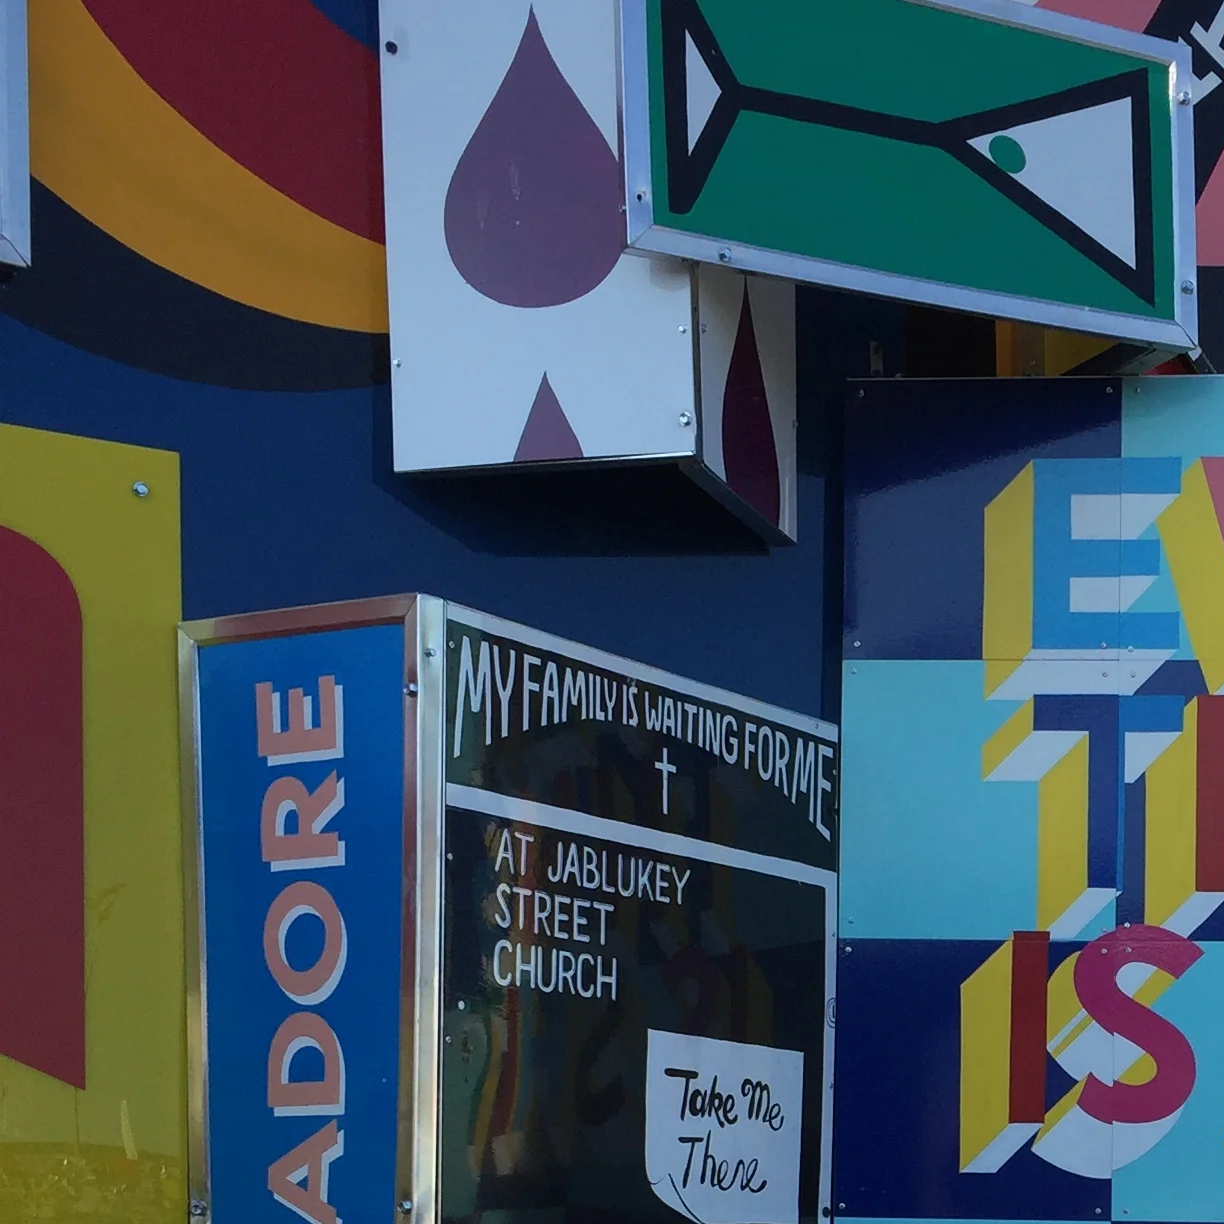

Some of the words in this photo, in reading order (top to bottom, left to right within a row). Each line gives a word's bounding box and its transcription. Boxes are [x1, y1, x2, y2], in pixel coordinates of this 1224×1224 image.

[453, 635, 516, 759] MY
[522, 652, 618, 732] FAMILY
[621, 684, 639, 728] IS
[644, 691, 739, 766] WAITING
[743, 721, 789, 798] FOR
[791, 737, 835, 843] ME
[494, 828, 535, 876] AT
[547, 844, 691, 906] JABLUKEY
[494, 884, 615, 947] STREET
[493, 940, 617, 1001] CHURCH
[1009, 925, 1206, 1127] IS
[664, 1067, 739, 1126] Take
[740, 1078, 785, 1131] Me
[678, 1131, 768, 1194] There
